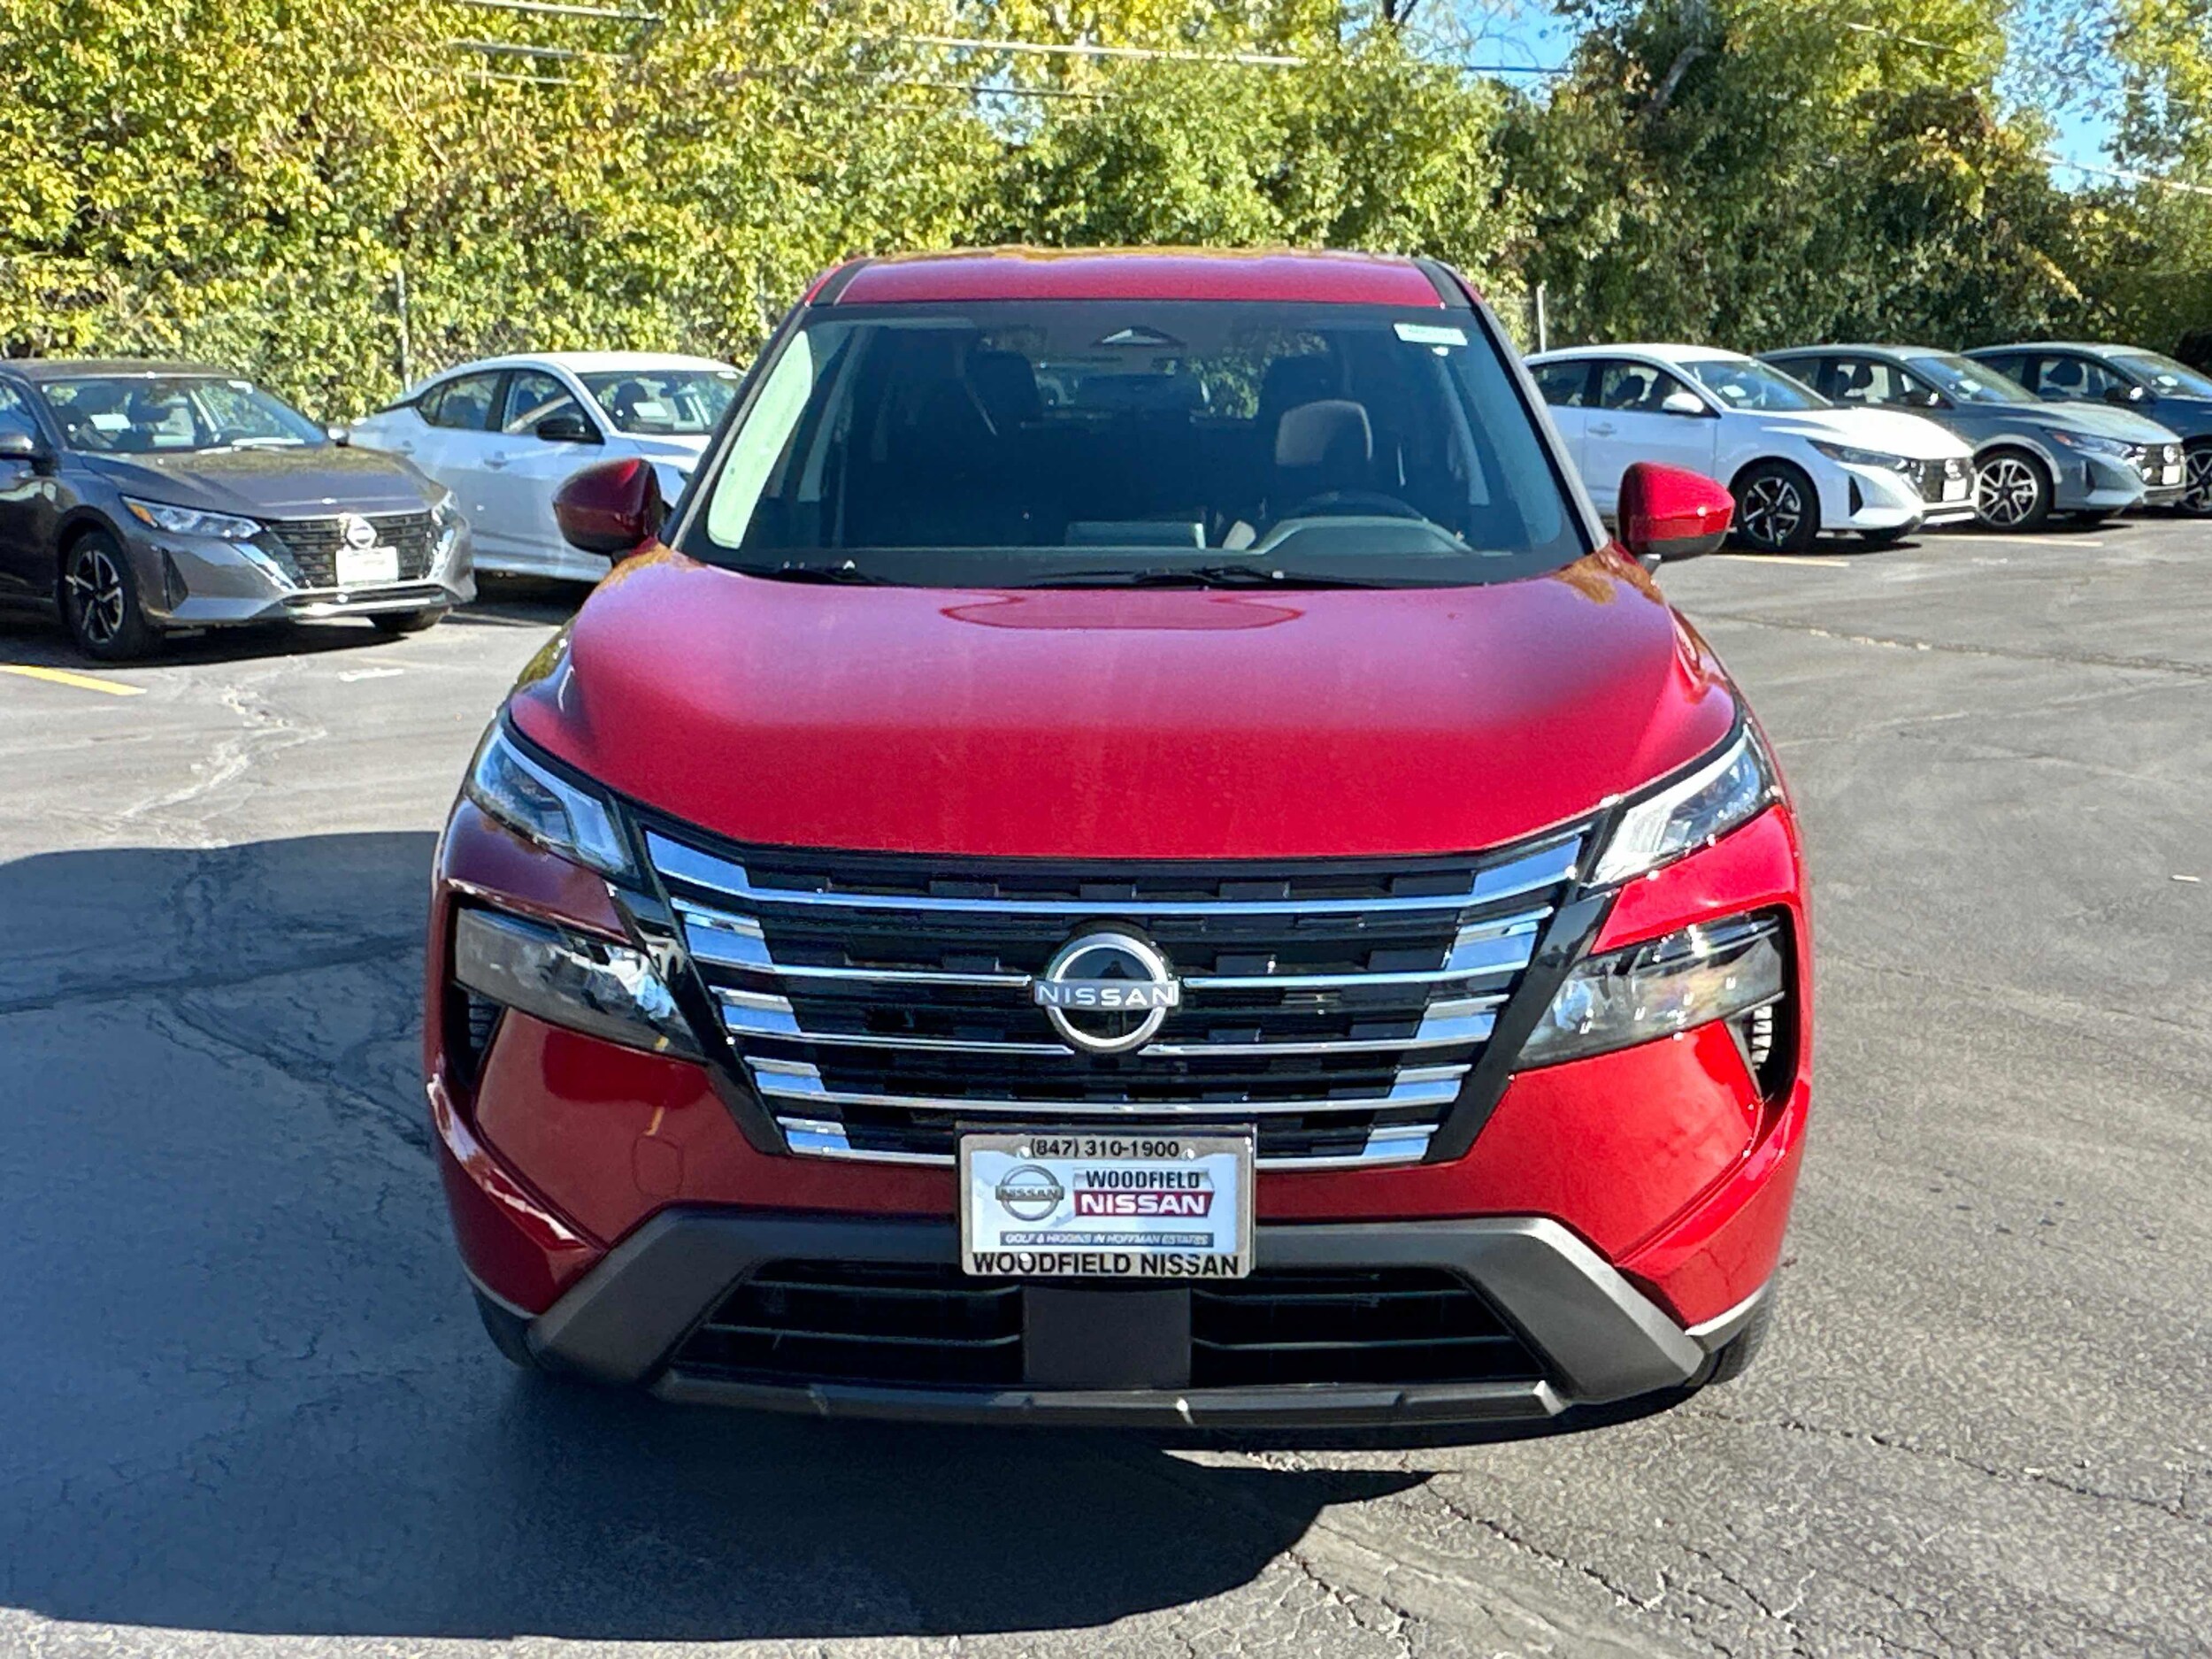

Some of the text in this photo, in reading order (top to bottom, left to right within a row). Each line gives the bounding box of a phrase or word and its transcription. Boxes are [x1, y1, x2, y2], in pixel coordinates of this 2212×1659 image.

[1037, 985, 1173, 1006] NISSAN
[1030, 1138, 1179, 1157] (847) 310-1900
[1085, 1170, 1201, 1189] WOODFIELD
[1001, 1187, 1060, 1198] NISSAN
[1080, 1193, 1206, 1215] NISSAN
[973, 1253, 1239, 1275] WOODFIELD NISSAN
